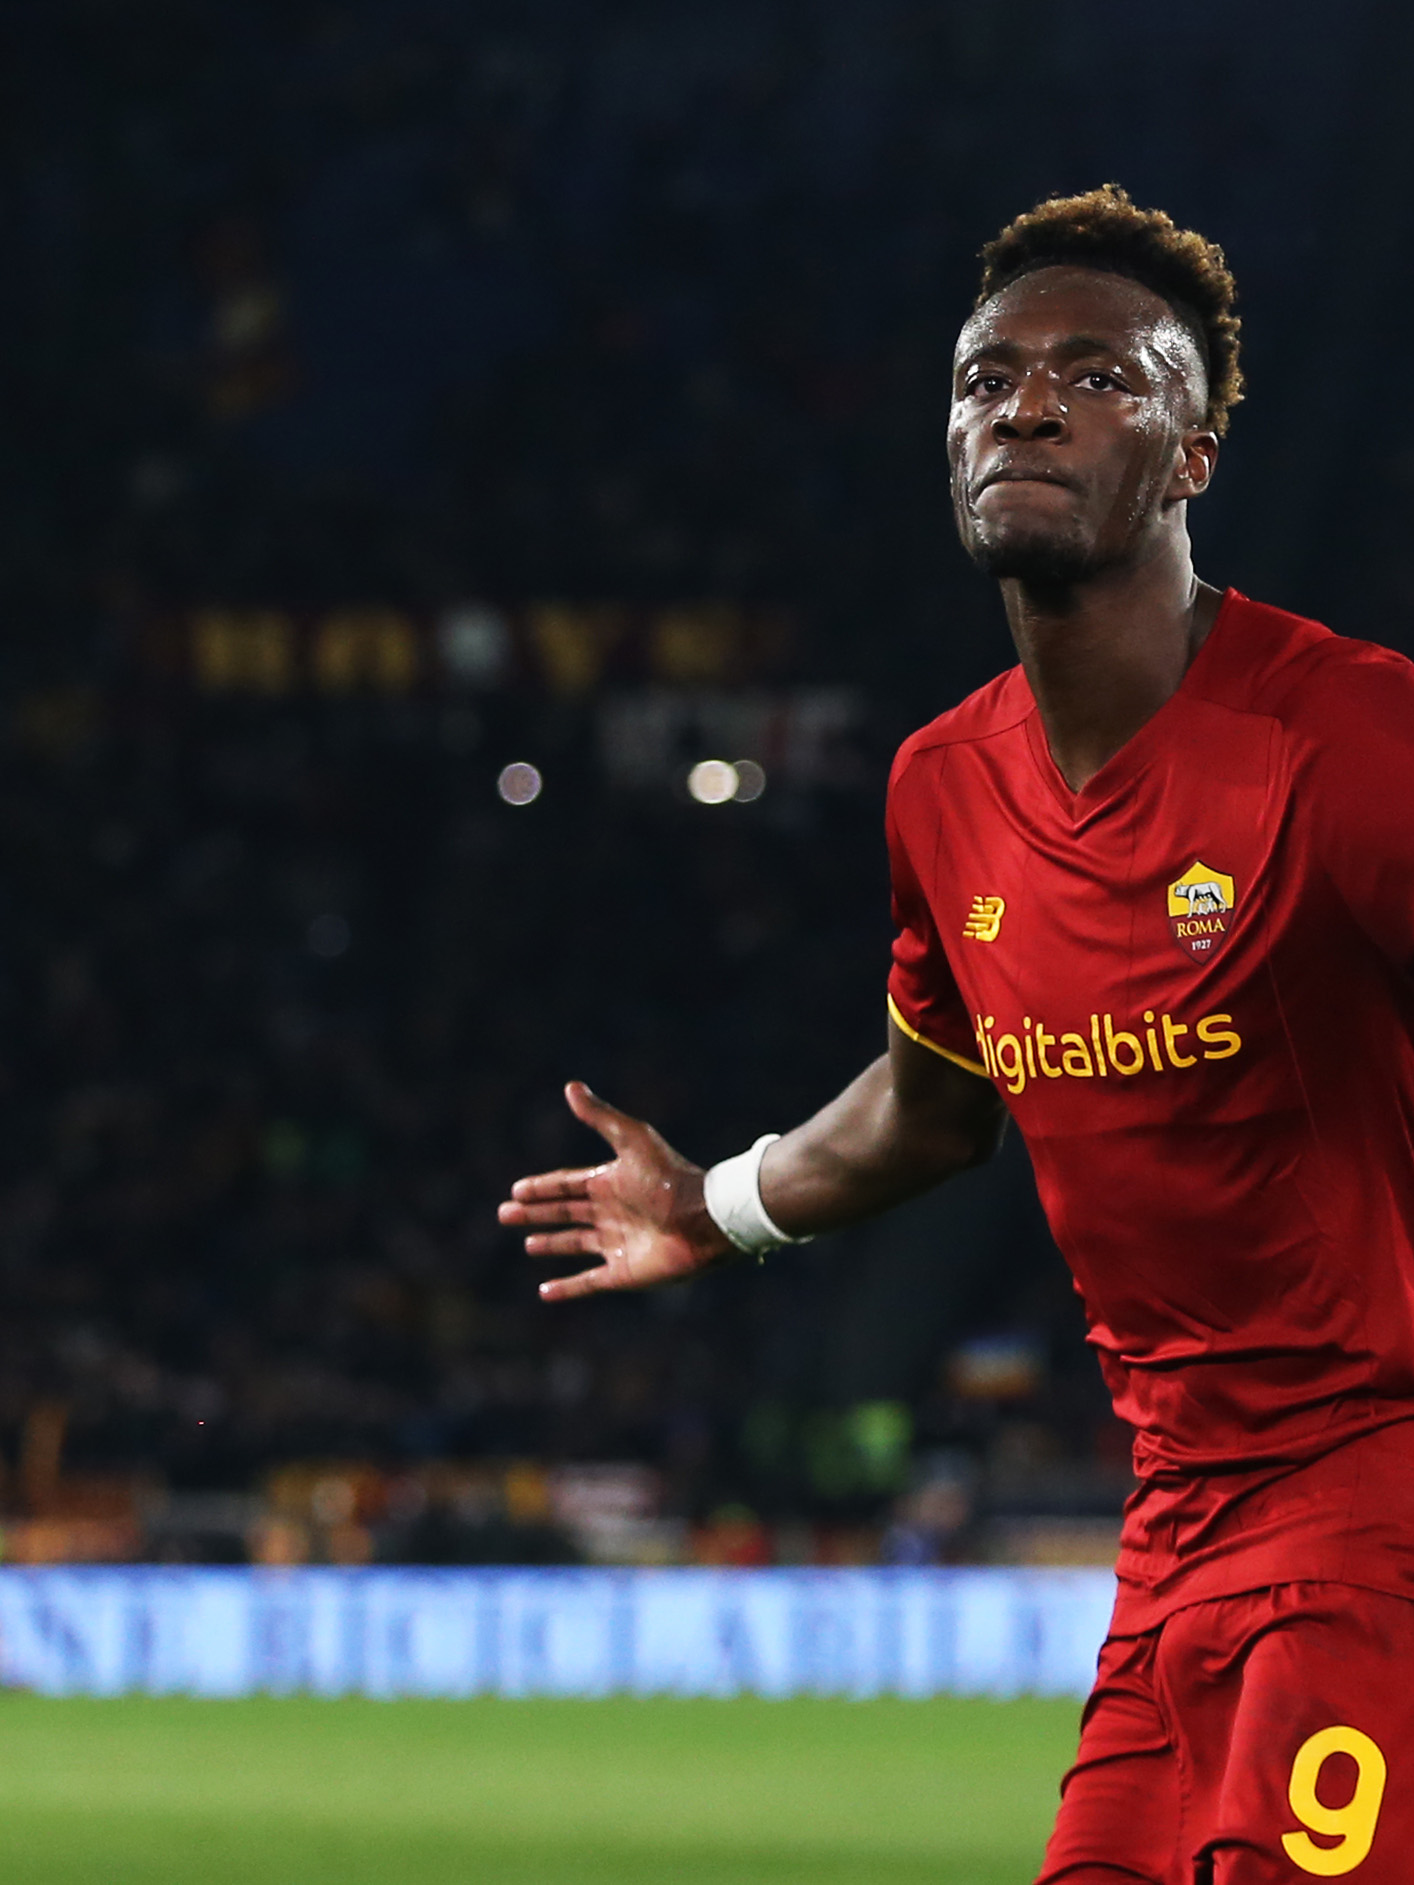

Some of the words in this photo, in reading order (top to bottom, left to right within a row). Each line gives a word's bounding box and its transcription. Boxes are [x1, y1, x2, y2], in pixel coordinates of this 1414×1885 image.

[1177, 918, 1226, 938] ROMA
[1192, 939, 1211, 951] 1927
[1281, 1725, 1387, 1876] 9
